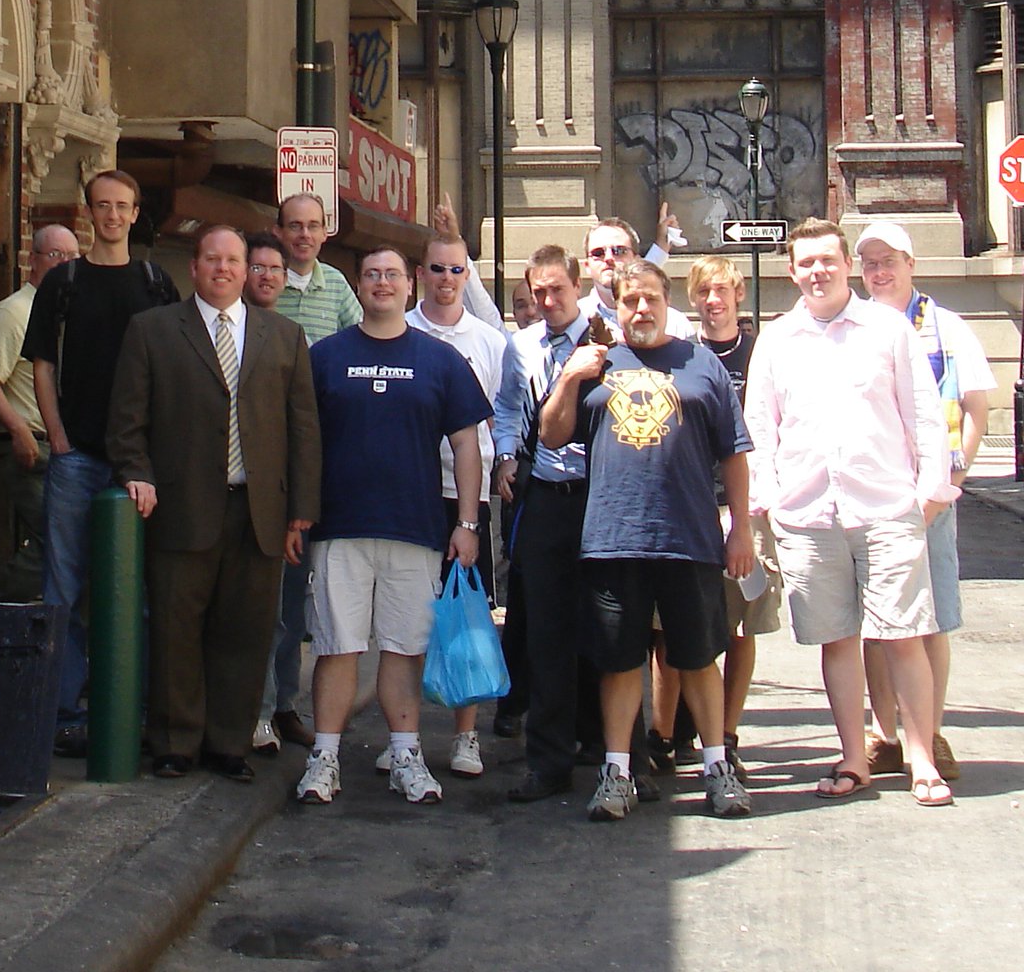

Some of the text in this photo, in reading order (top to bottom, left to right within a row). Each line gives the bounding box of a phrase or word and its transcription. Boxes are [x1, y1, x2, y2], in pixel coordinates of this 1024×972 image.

[280, 151, 334, 170] NO PARKING
[358, 137, 411, 212] SPOT
[301, 178, 314, 192] IN
[741, 228, 780, 237] ONE WAY
[347, 365, 414, 378] PENN STATE
